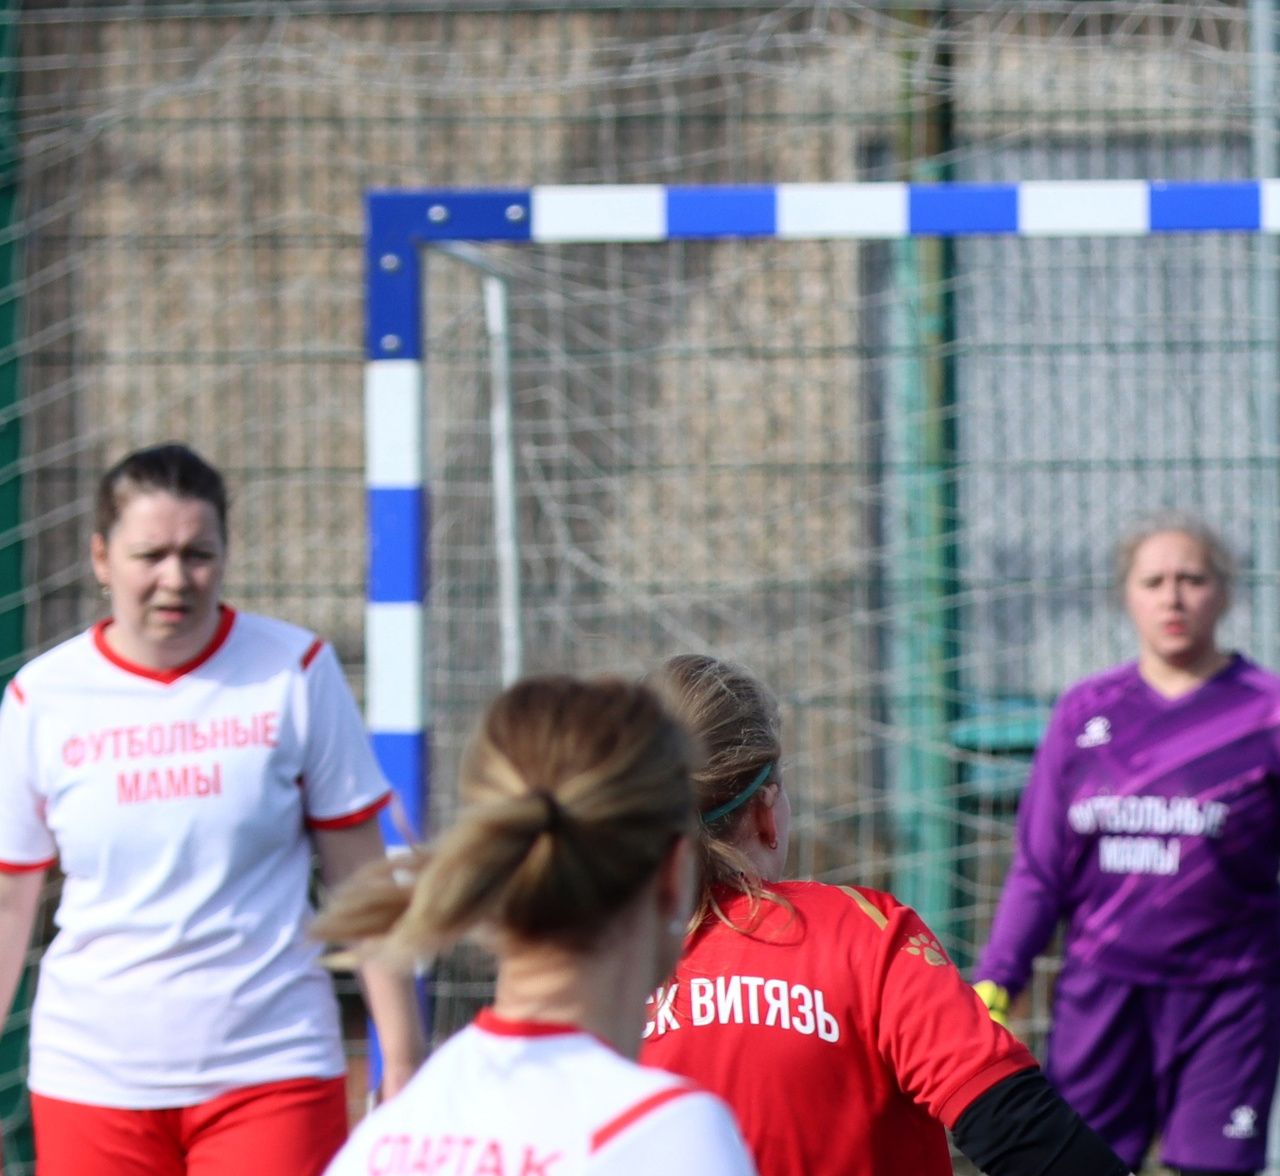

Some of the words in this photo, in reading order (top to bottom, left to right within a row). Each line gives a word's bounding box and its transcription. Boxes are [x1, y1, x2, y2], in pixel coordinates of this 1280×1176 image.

[62, 711, 281, 768] ФУТБОЛЬНЫЕ
[116, 763, 222, 804] МАМЫ
[690, 975, 840, 1044] ВИТЯЗЬ
